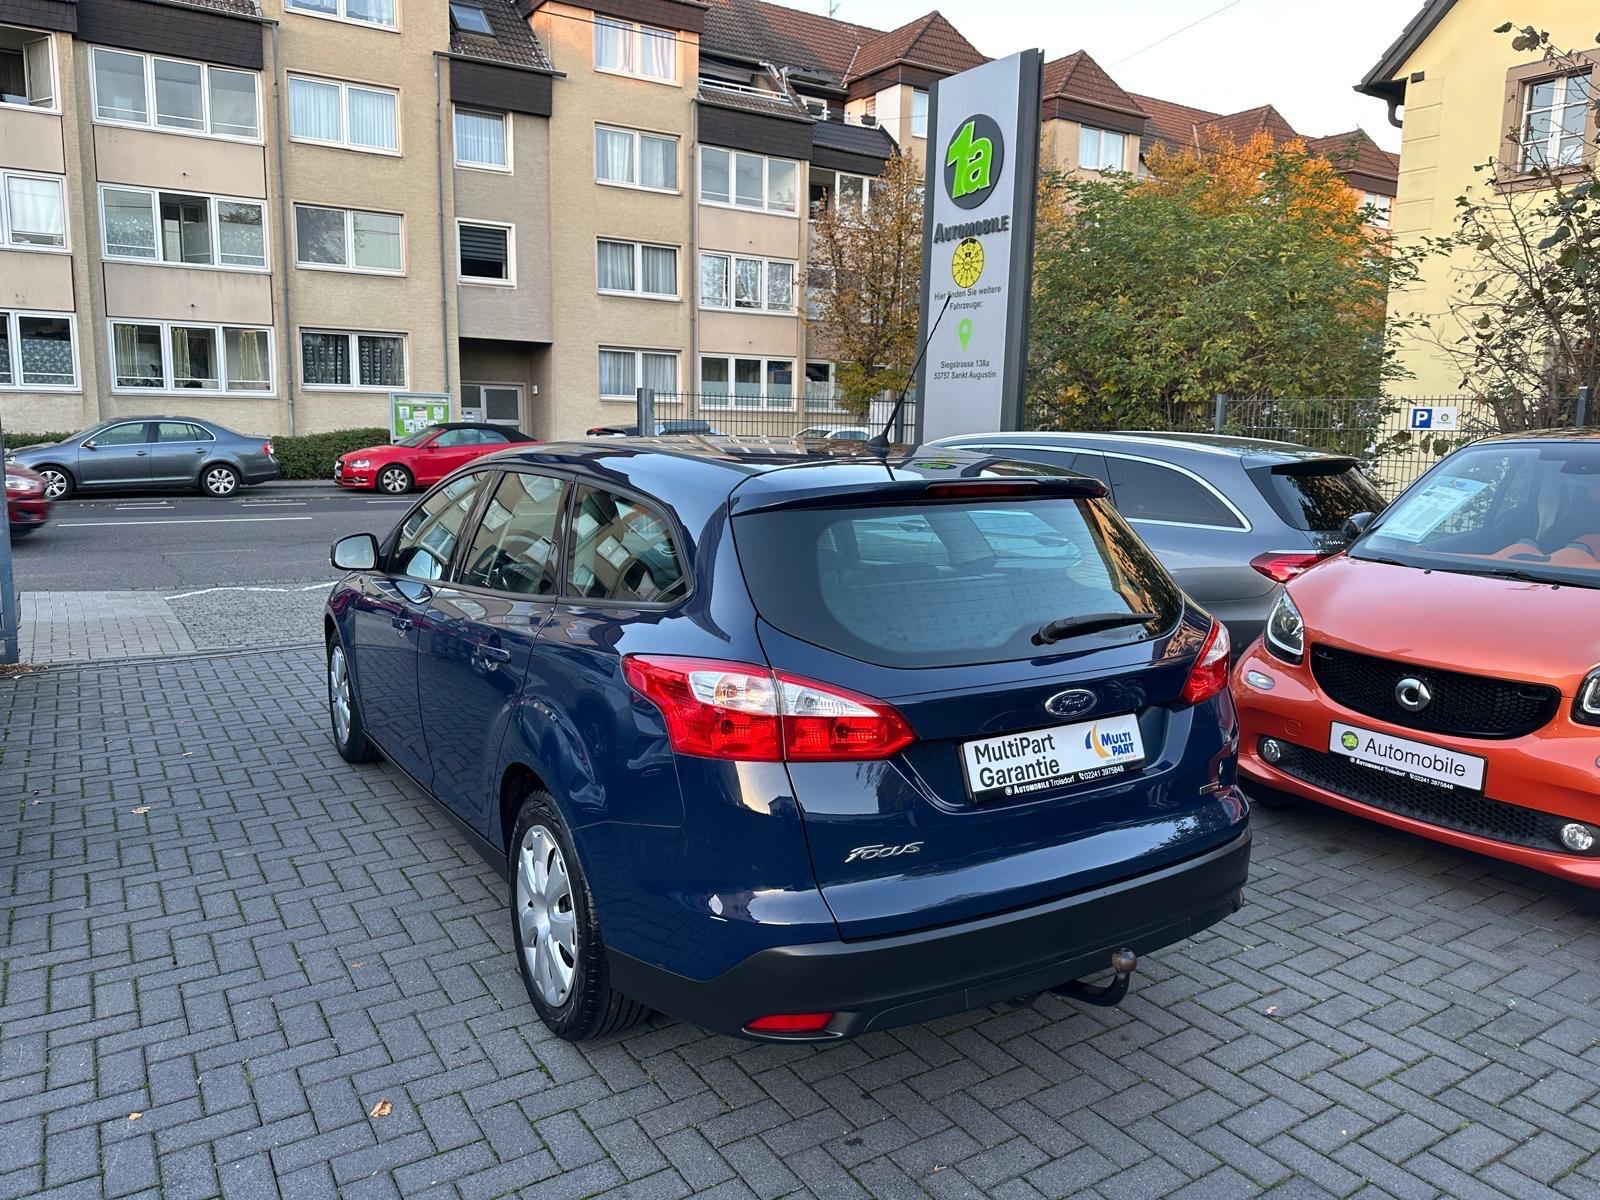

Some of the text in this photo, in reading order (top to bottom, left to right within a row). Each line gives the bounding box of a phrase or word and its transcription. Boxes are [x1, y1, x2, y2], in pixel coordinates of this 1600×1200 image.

[947, 121, 993, 198] 1a
[933, 215, 1010, 243] AUTOMOBILE
[934, 291, 946, 300] Hier
[967, 288, 977, 297] Sie
[978, 285, 1002, 295] weitere
[949, 301, 983, 311] Fahrzeuge:
[940, 359, 990, 370] Siegstrasse 138a
[934, 370, 997, 380] 53757 Sankt Augustin
[1415, 411, 1428, 426] P
[1101, 731, 1132, 746] MULTI
[973, 733, 1055, 764] MultiPart
[1111, 742, 1135, 756] PART
[1364, 737, 1466, 777] Automobile
[979, 756, 1060, 787] Garantie
[1014, 780, 1050, 795] AUTOMOBILE
[1050, 775, 1075, 788] Troisdorf
[1083, 769, 1101, 780] 02241
[1101, 765, 1125, 777] 3975848
